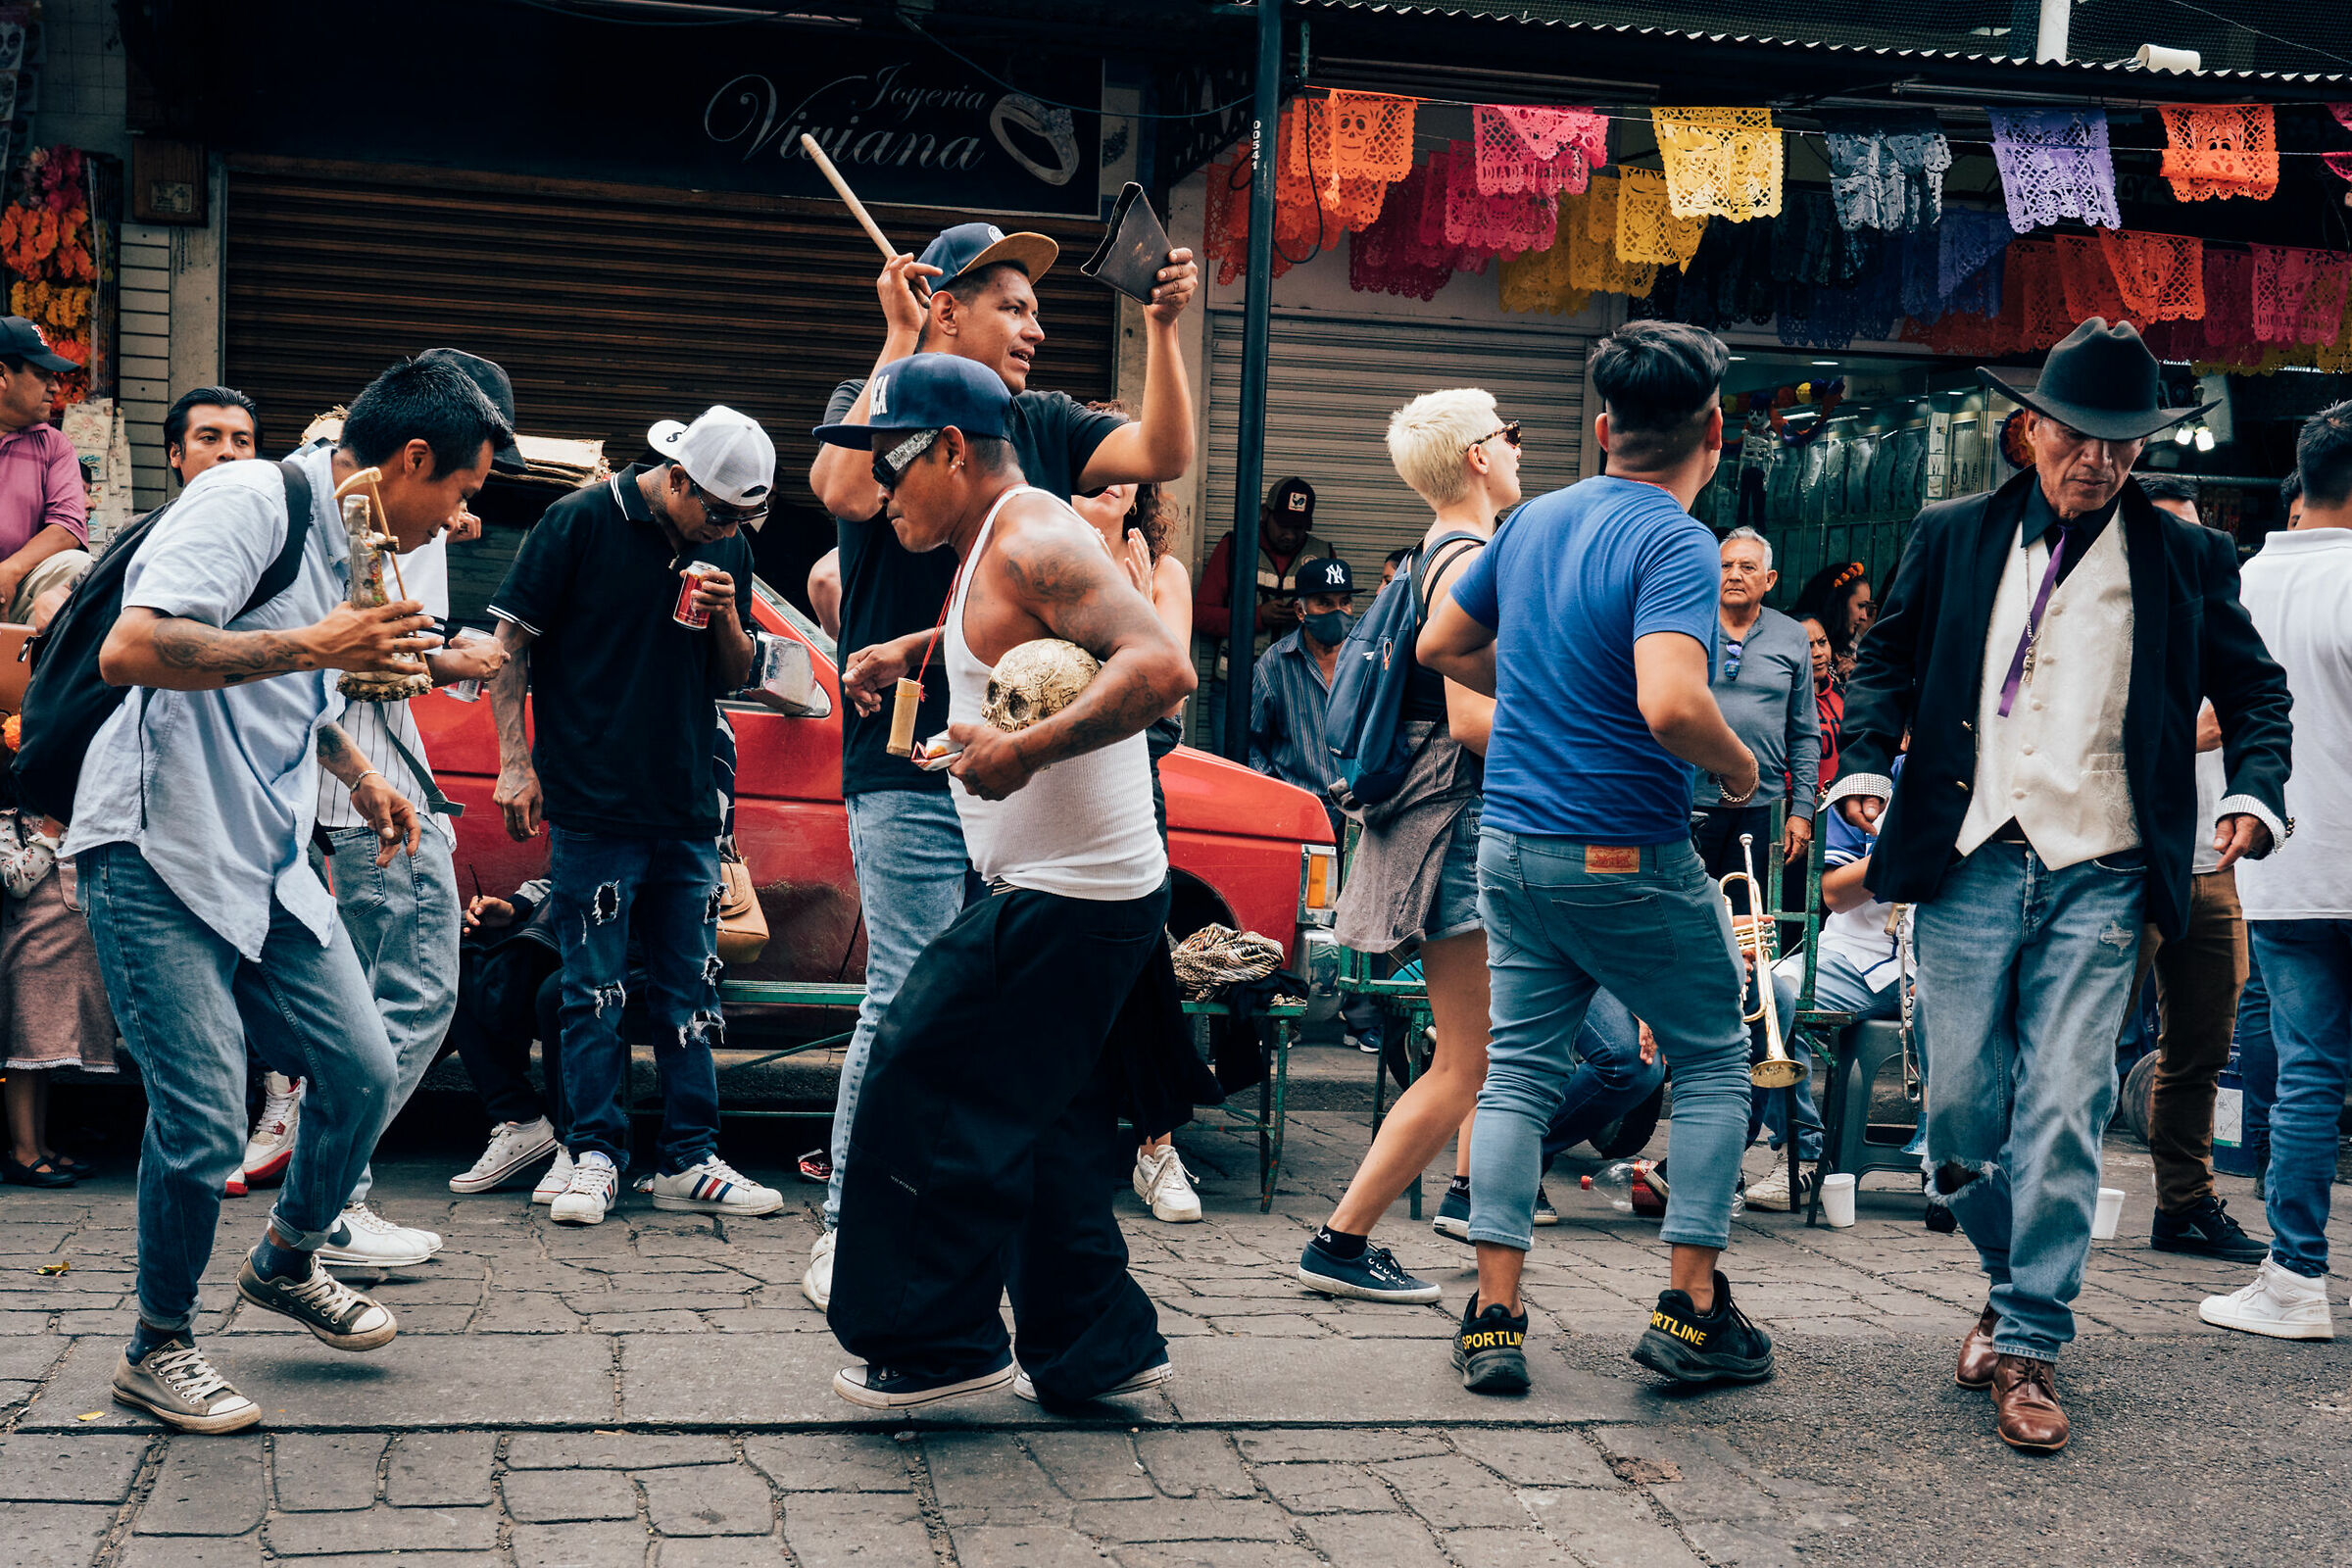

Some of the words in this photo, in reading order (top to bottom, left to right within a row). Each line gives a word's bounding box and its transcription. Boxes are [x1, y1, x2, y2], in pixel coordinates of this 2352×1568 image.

[705, 74, 986, 171] Viviana
[1251, 120, 1261, 170] 00541
[1326, 564, 1346, 585] NY
